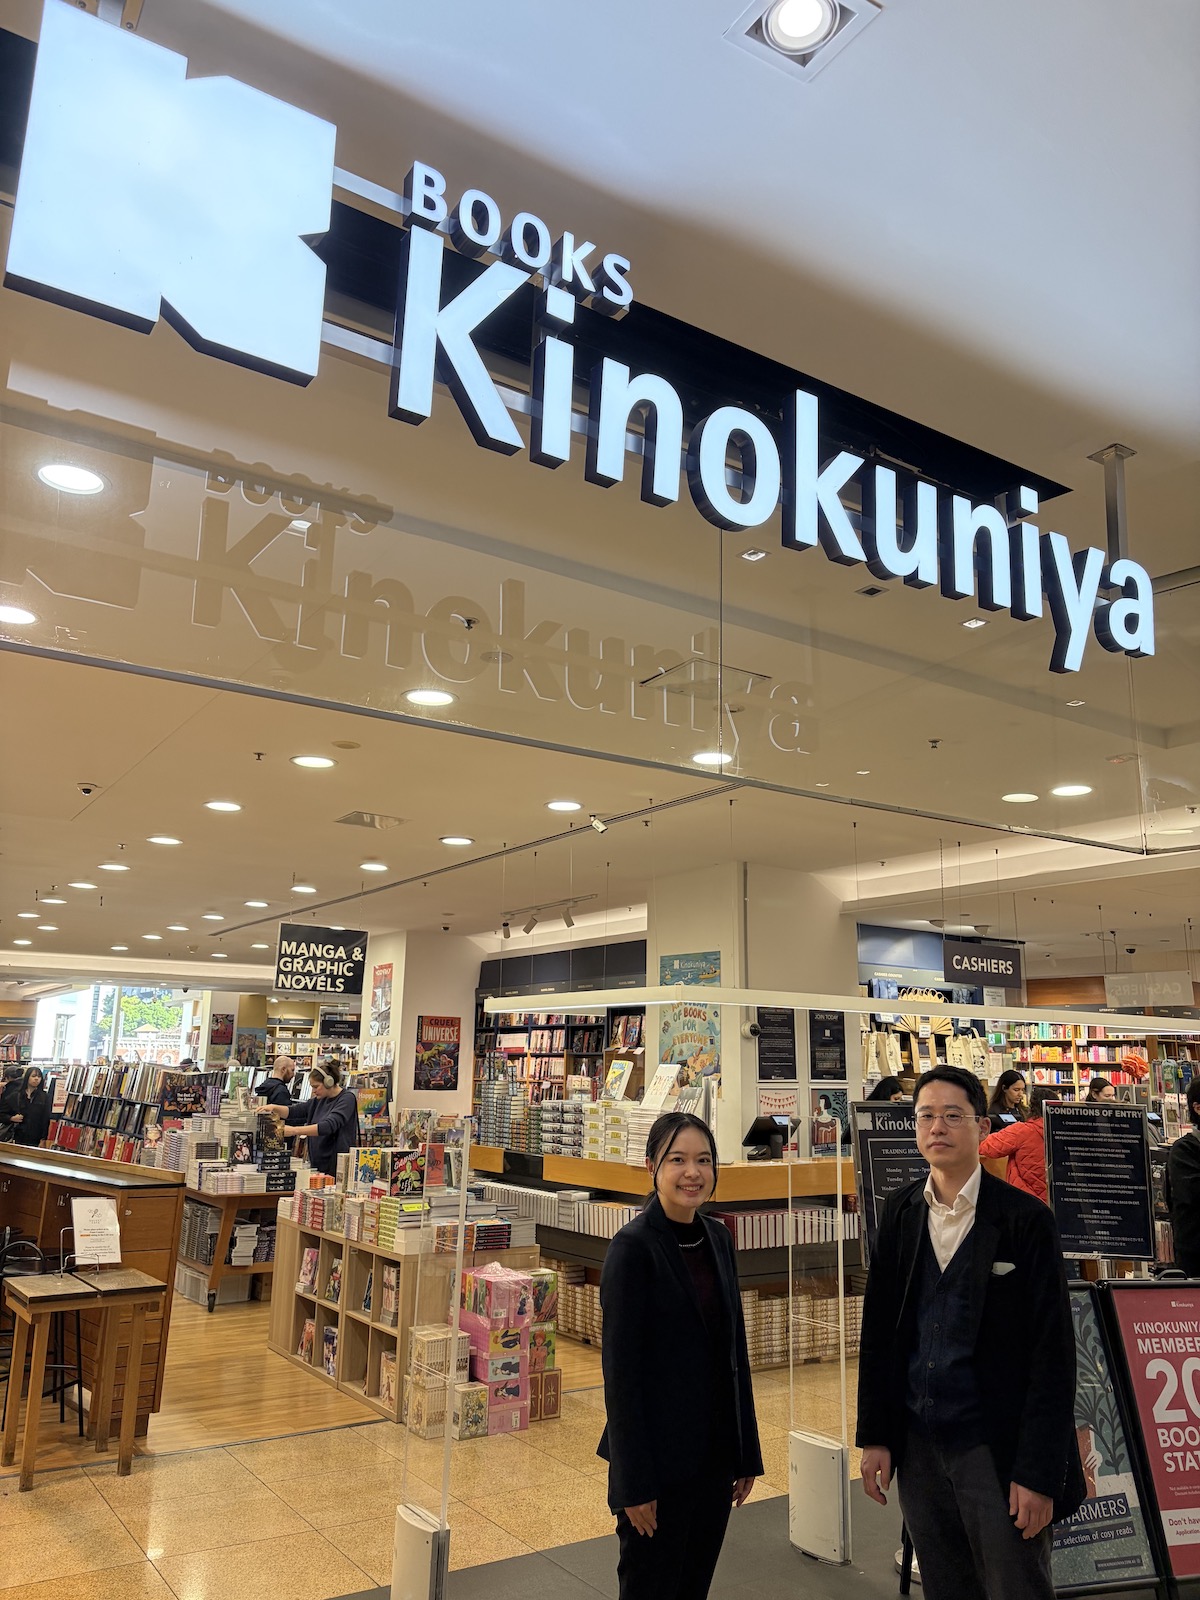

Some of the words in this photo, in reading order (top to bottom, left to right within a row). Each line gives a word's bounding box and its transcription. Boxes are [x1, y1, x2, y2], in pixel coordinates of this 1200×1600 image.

[403, 160, 634, 312] BOOKS
[389, 224, 1155, 674] Kinokuniya
[281, 940, 347, 960] MANGA
[352, 947, 364, 961] &
[279, 957, 355, 977] GRAPHIC
[952, 955, 1013, 975] CASHIERS
[278, 974, 345, 992] NOVELS
[429, 1018, 454, 1027] CRUEL
[683, 1007, 707, 1022] BOOKS
[423, 1025, 459, 1041] UNIVERSE
[682, 1019, 697, 1031] FOR
[672, 1032, 709, 1046] EVERYONE
[1049, 1107, 1100, 1117] CONDITIONS
[1102, 1109, 1113, 1117] OF
[1115, 1110, 1143, 1119] ENTRY
[1133, 1321, 1200, 1334] KINOKUNIY
[1157, 1425, 1200, 1448] BOO
[1168, 1517, 1187, 1526] Don't
[1063, 1534, 1091, 1546] selection
[1092, 1530, 1099, 1541] of
[1100, 1530, 1114, 1540] cosy
[1116, 1525, 1133, 1536] reads
